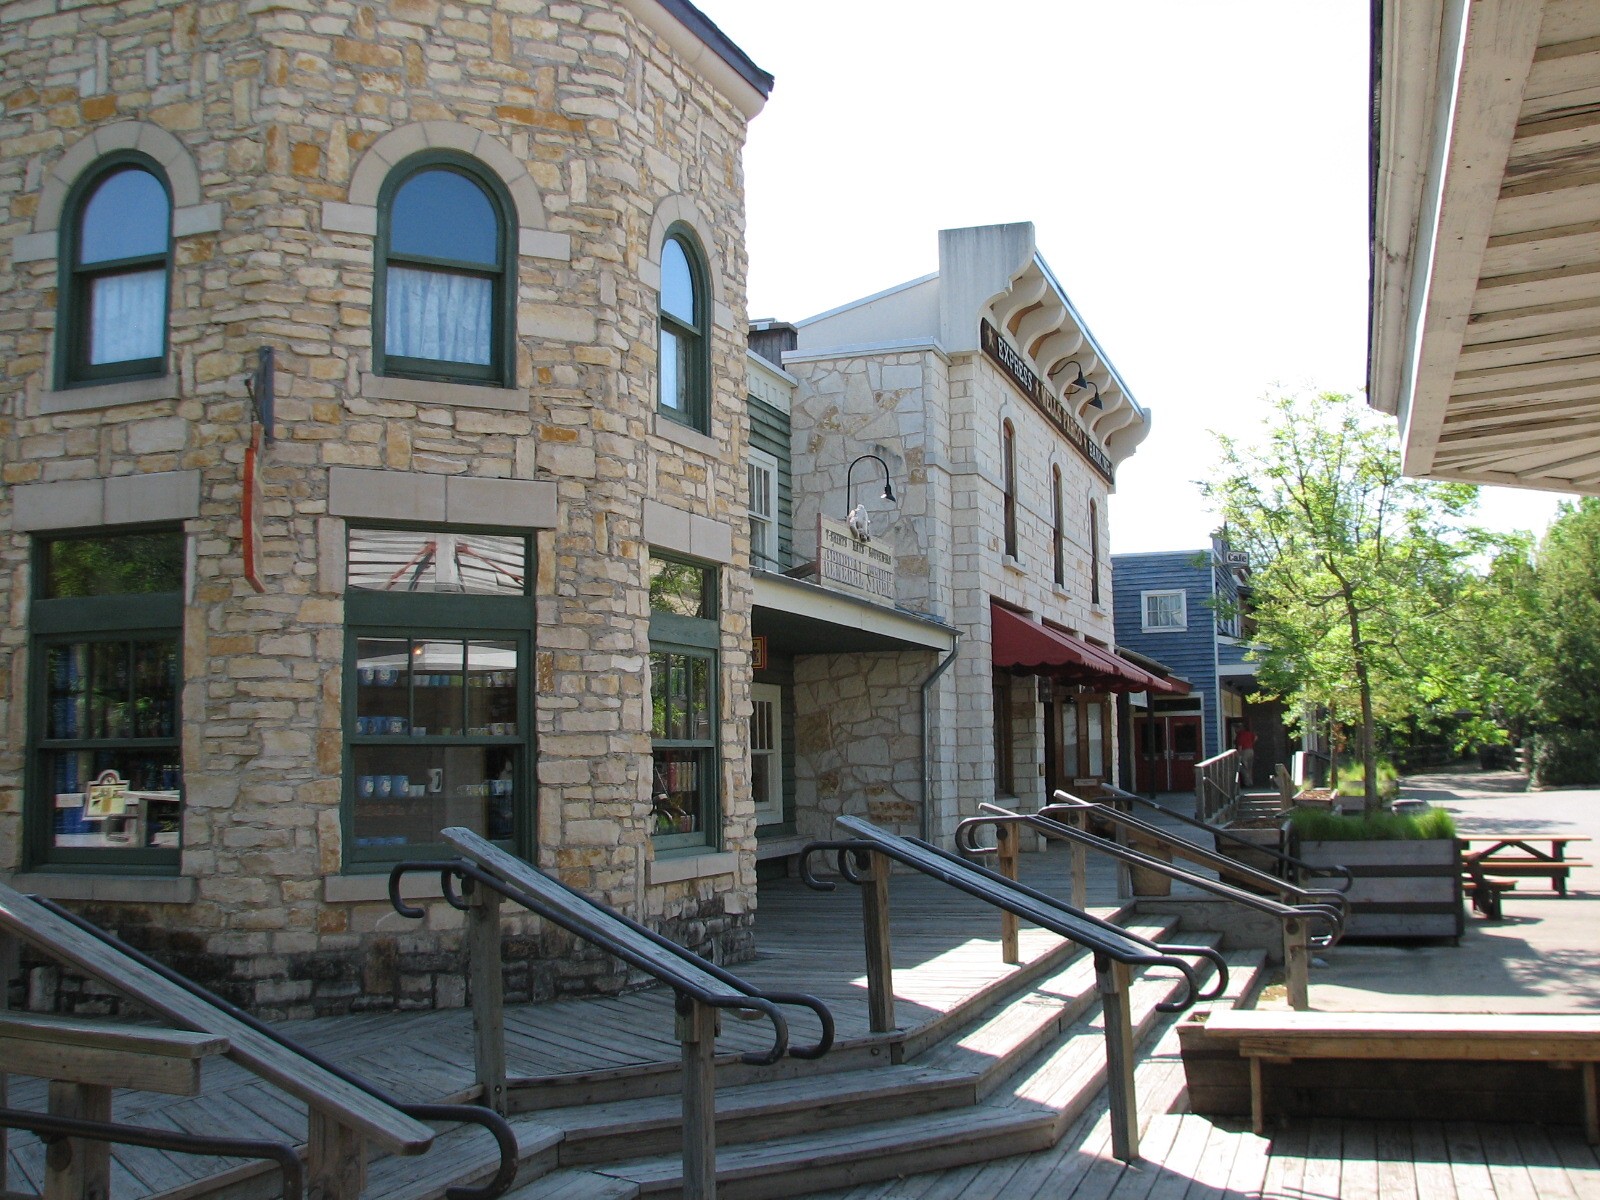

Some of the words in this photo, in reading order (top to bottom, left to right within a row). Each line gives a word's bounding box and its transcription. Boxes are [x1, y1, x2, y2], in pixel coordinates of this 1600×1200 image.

[997, 336, 1033, 392] EXPRESS
[1041, 384, 1062, 424] WELLS
[853, 540, 865, 554] HATS
[1228, 552, 1247, 562] Cafe
